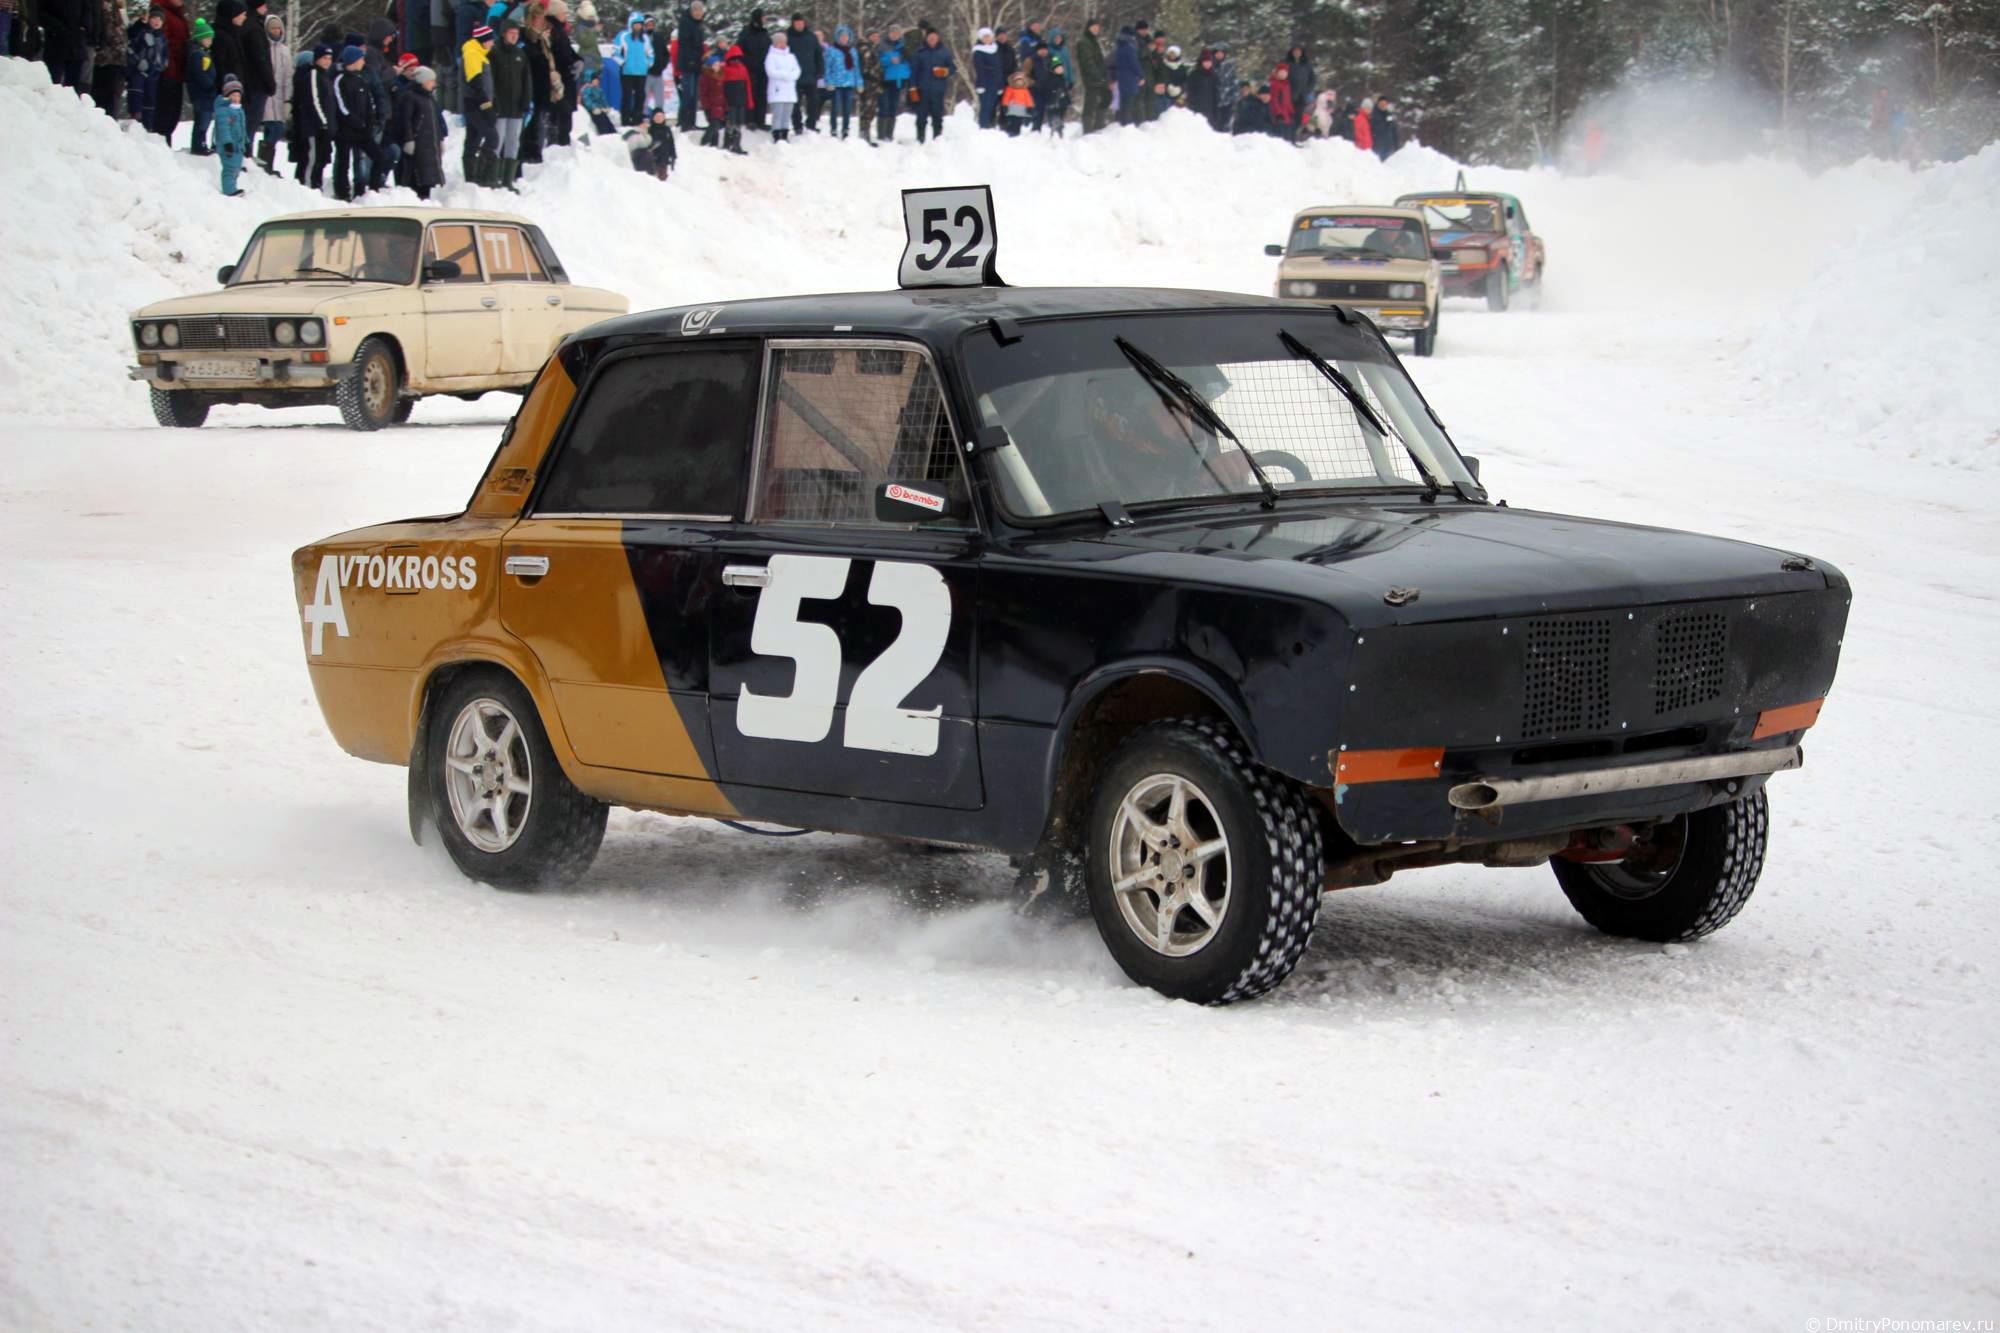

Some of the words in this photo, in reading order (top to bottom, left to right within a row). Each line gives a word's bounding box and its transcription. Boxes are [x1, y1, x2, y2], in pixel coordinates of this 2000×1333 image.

[916, 205, 984, 271] 52
[903, 490, 940, 506] brembo
[304, 555, 478, 656] AVTOKROSS
[736, 553, 952, 757] 52
